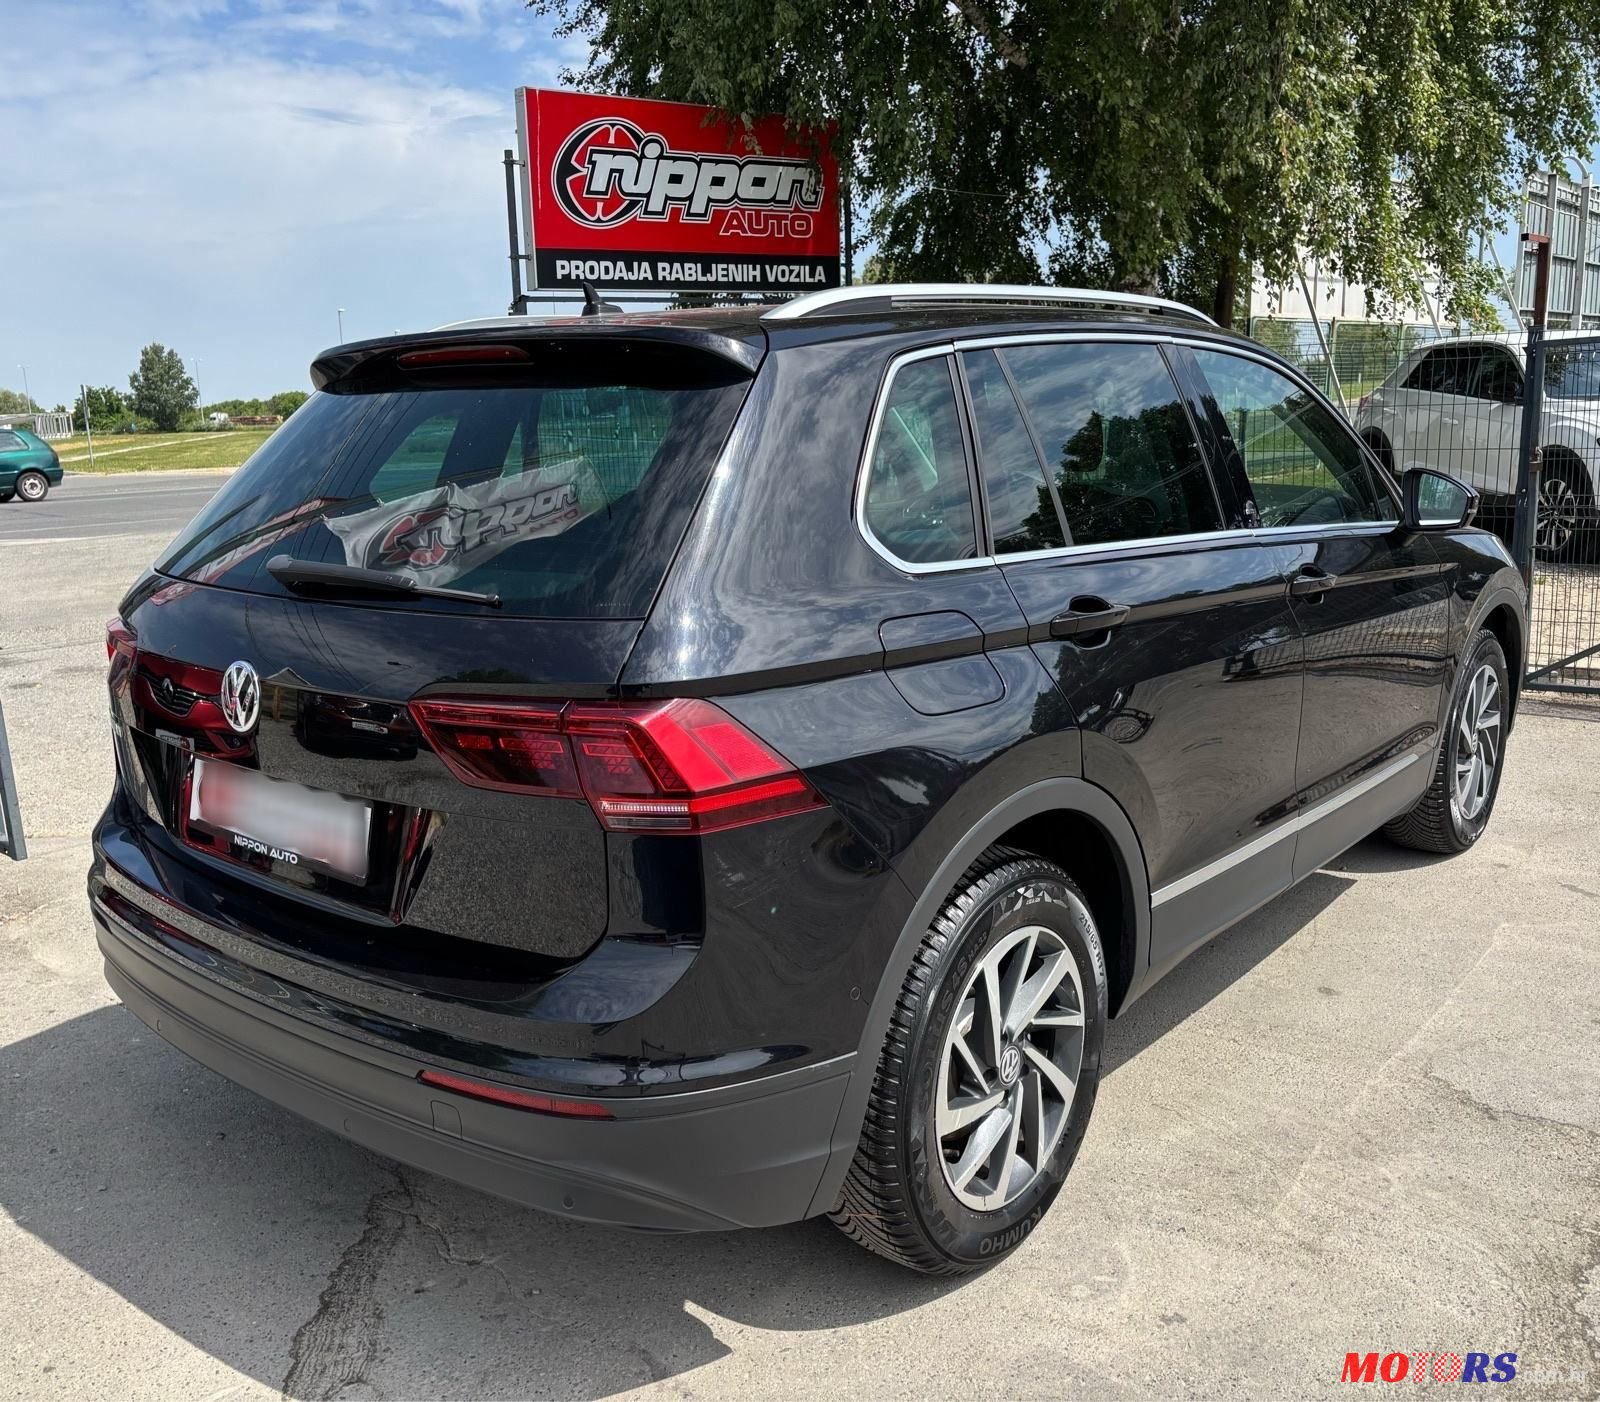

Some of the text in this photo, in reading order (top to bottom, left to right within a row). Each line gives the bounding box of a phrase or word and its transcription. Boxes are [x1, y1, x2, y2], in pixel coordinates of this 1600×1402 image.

[584, 136, 824, 221] nippon
[719, 210, 814, 238] AUTO
[555, 260, 826, 283] PRODAJA RABLJENIH VOZILA
[234, 834, 298, 865] NIPPON AUTO
[979, 1206, 1042, 1255] KUMHO
